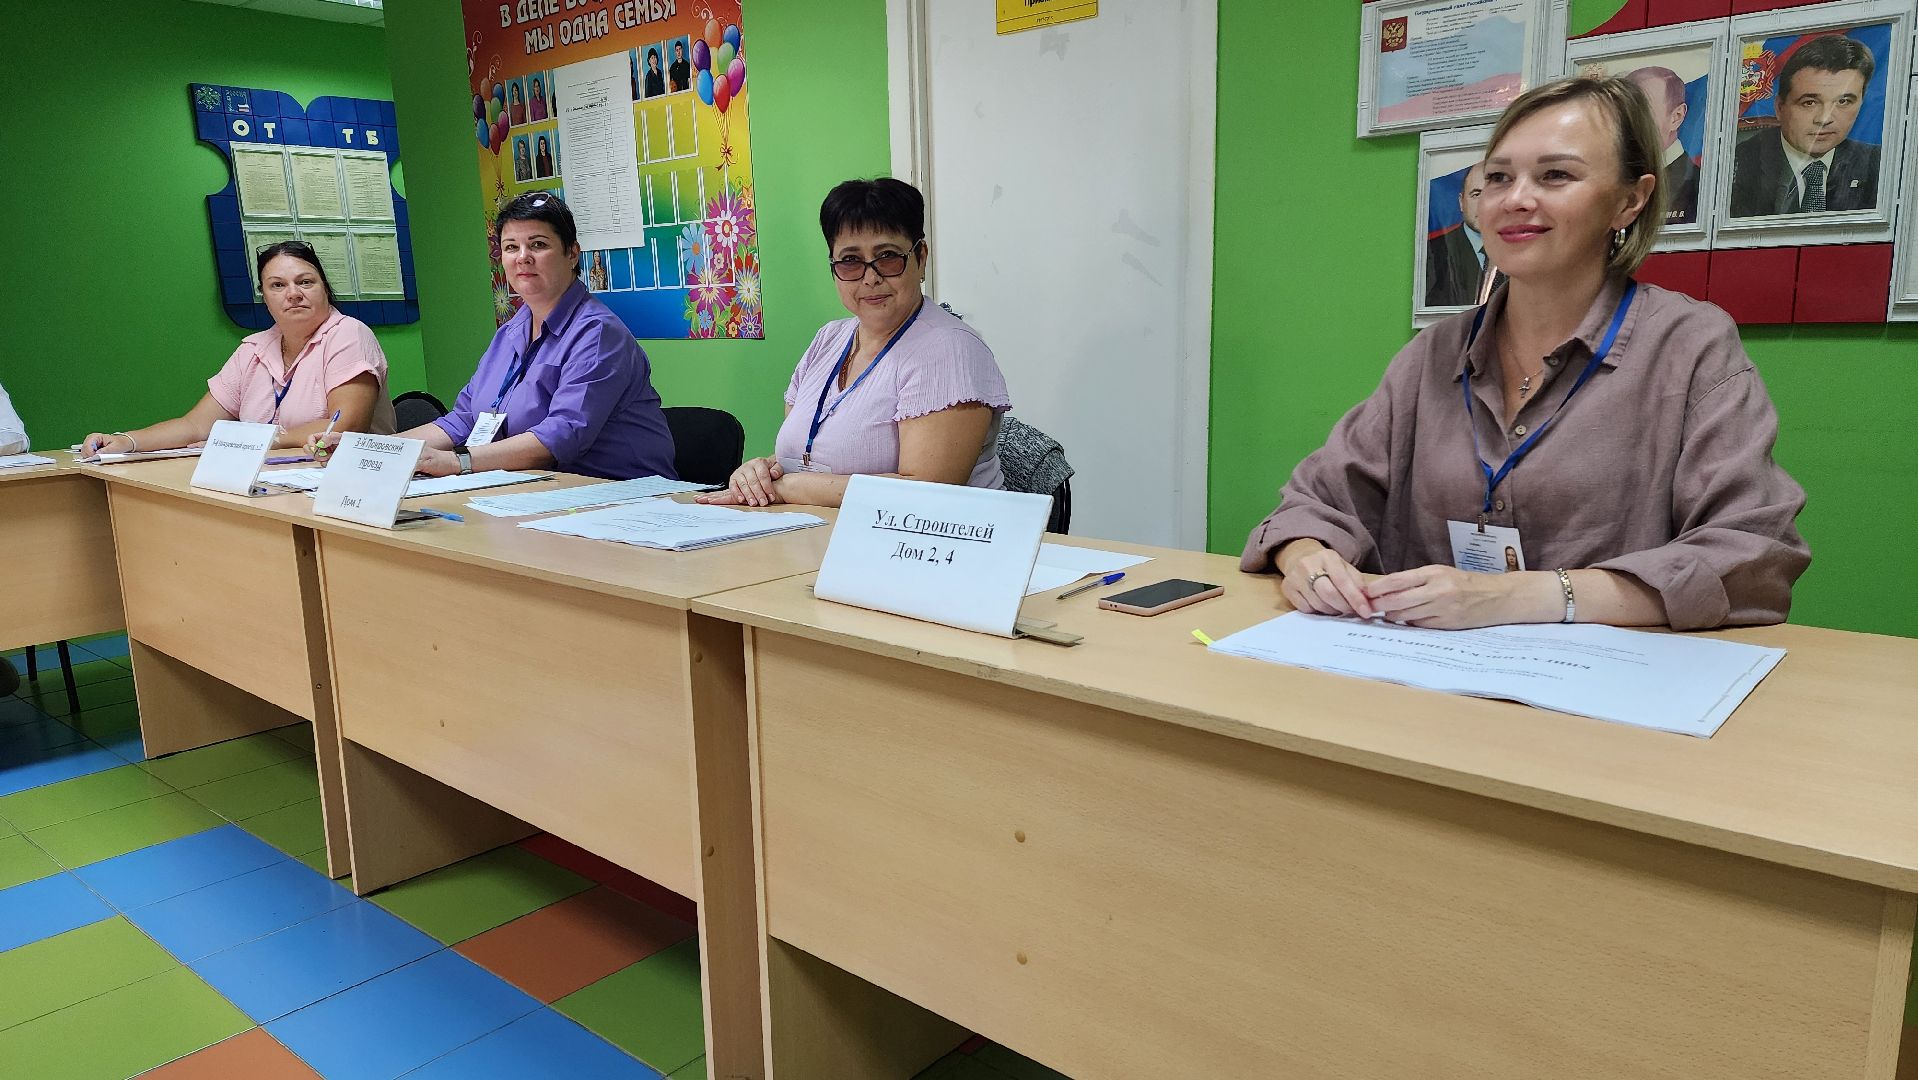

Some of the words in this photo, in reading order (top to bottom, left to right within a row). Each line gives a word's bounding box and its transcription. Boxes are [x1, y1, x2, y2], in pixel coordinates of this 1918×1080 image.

[500, 4, 512, 28] В
[524, 25, 554, 54] МЫ
[559, 9, 609, 46] ОДНА
[613, 0, 676, 30] СЕМЬЯ
[355, 437, 367, 448] 3-й
[366, 438, 404, 453] Покровский
[359, 458, 383, 472] проезд
[341, 495, 356, 508] Дом
[875, 509, 898, 527] Ул.
[903, 513, 995, 540] Строителей
[890, 541, 925, 561] Дом
[927, 546, 940, 567] 2,
[944, 549, 955, 565] 4
